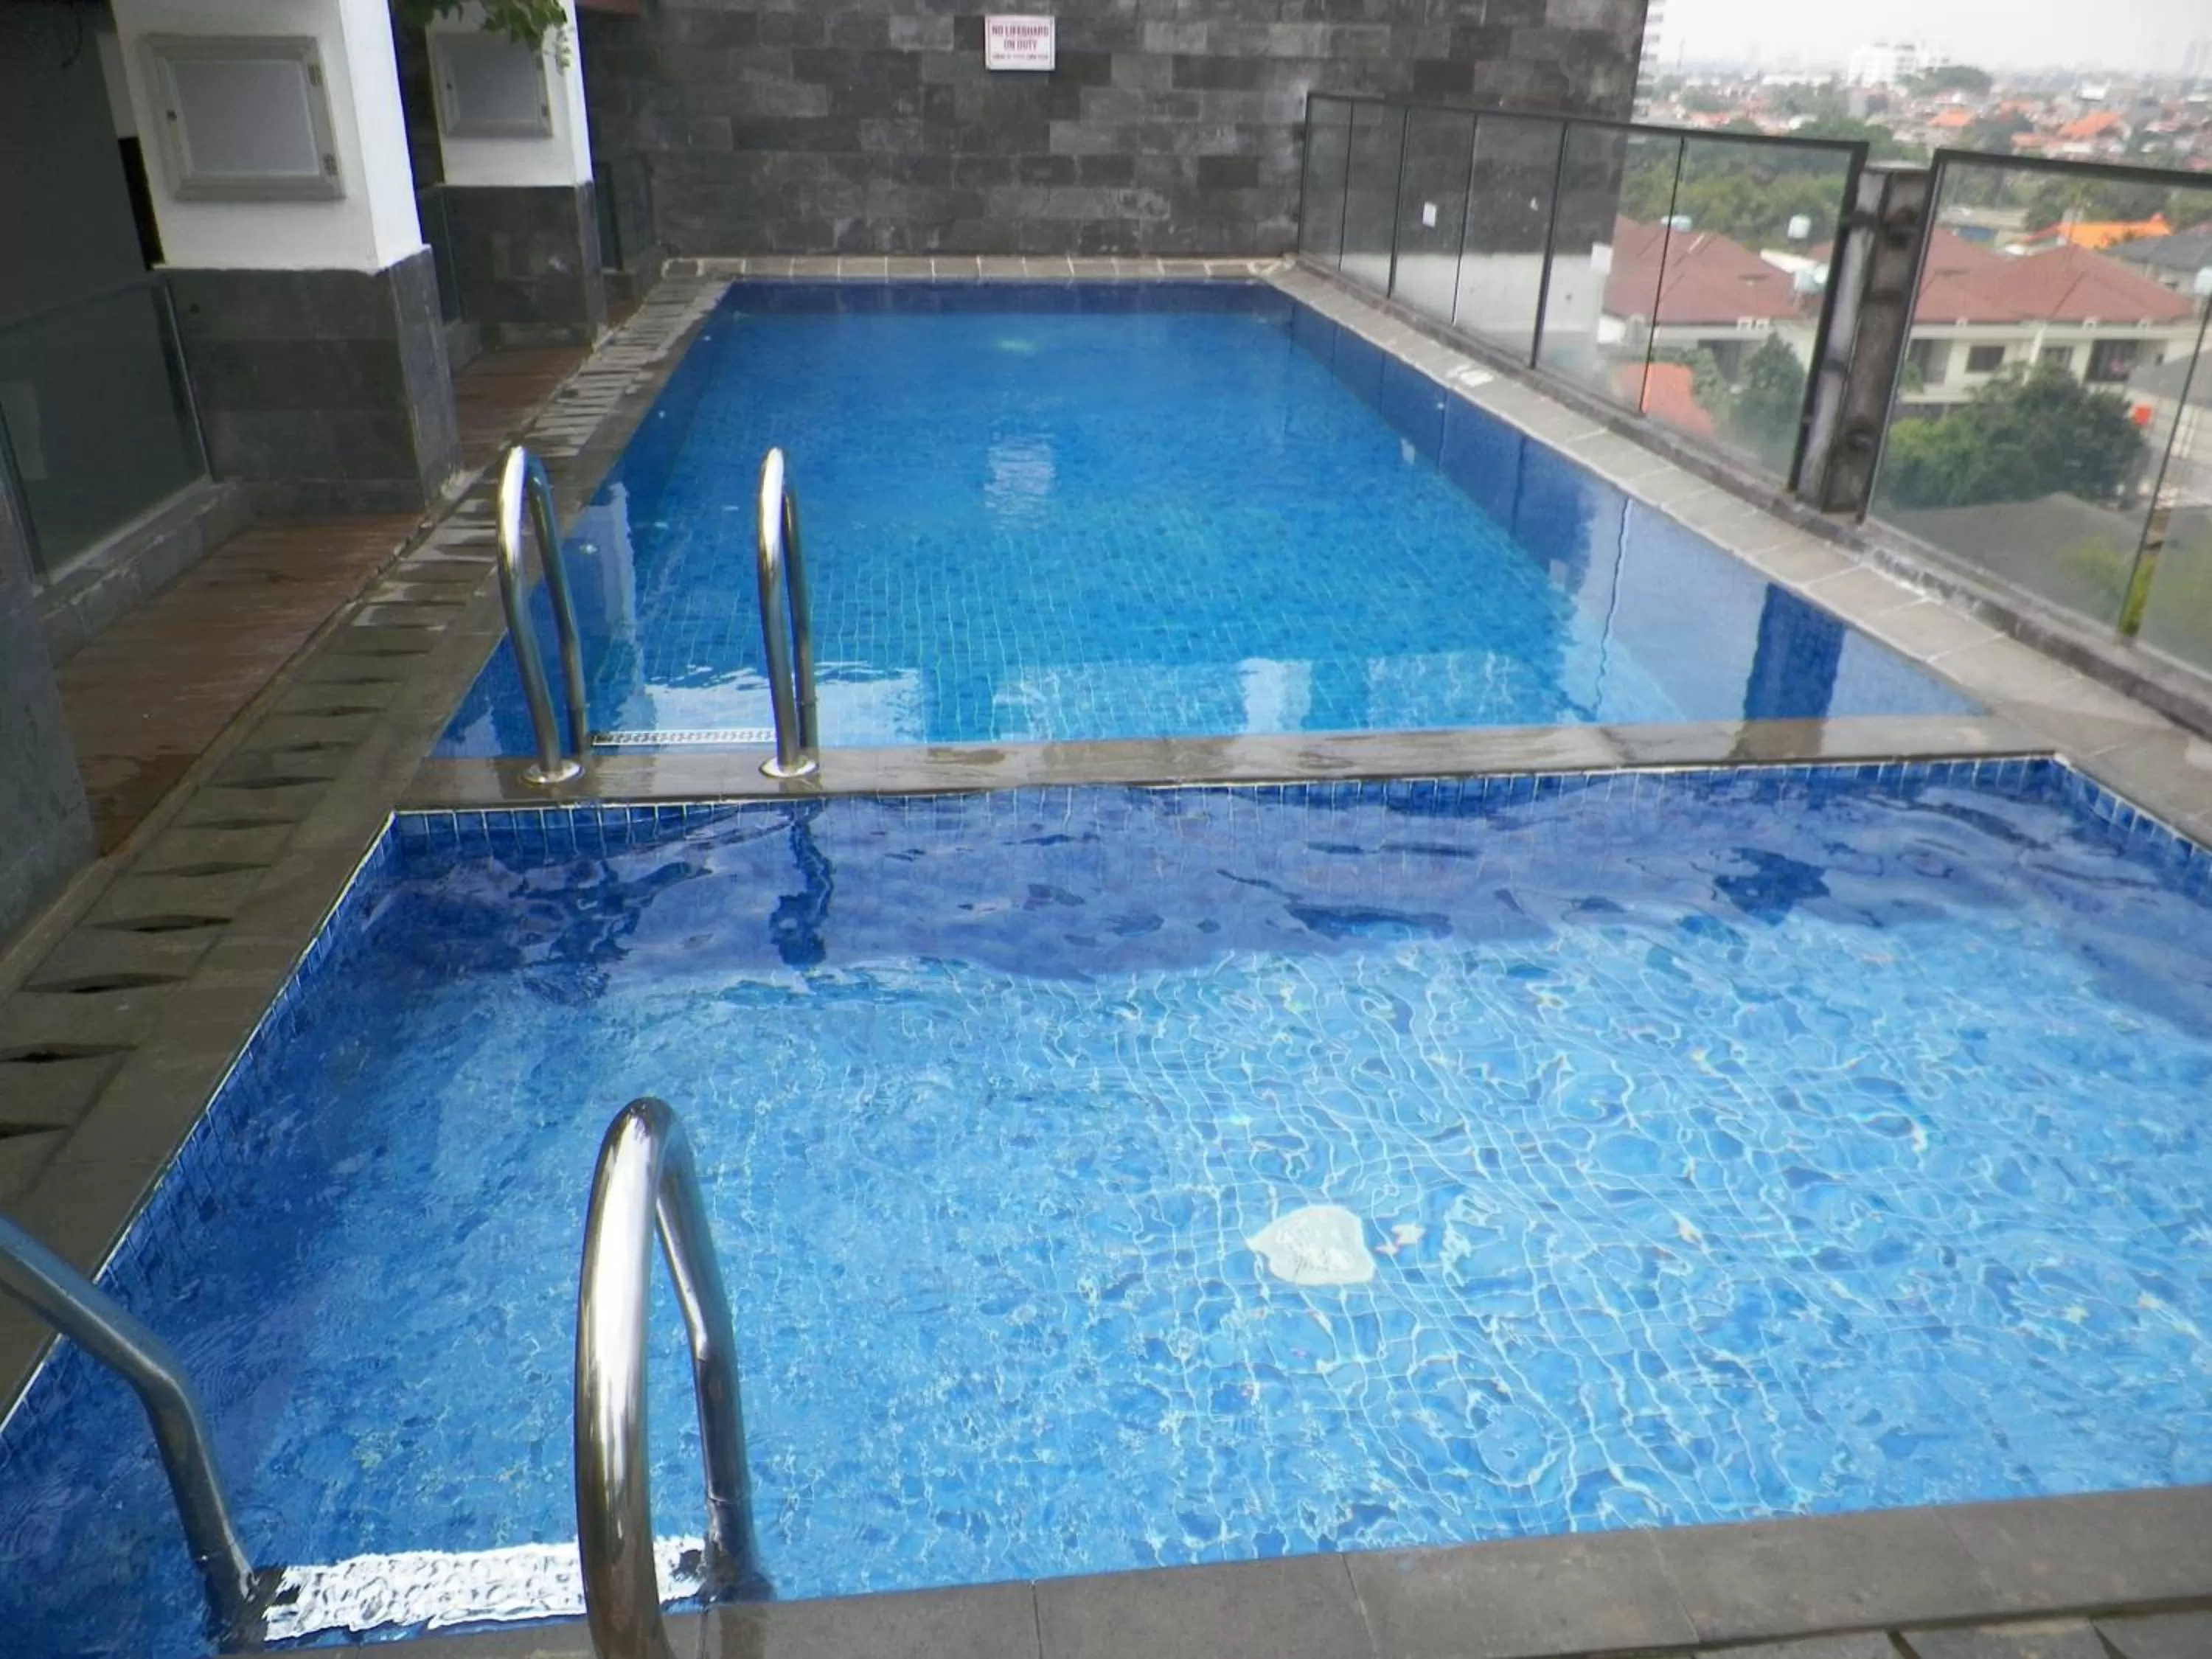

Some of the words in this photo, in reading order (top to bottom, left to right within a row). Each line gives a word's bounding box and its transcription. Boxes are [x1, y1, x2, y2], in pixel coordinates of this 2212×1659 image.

[992, 25, 1004, 36] NO
[1005, 25, 1049, 37] LIFEGUARD
[1004, 39, 1015, 50] ON
[1017, 39, 1037, 50] DUTY
